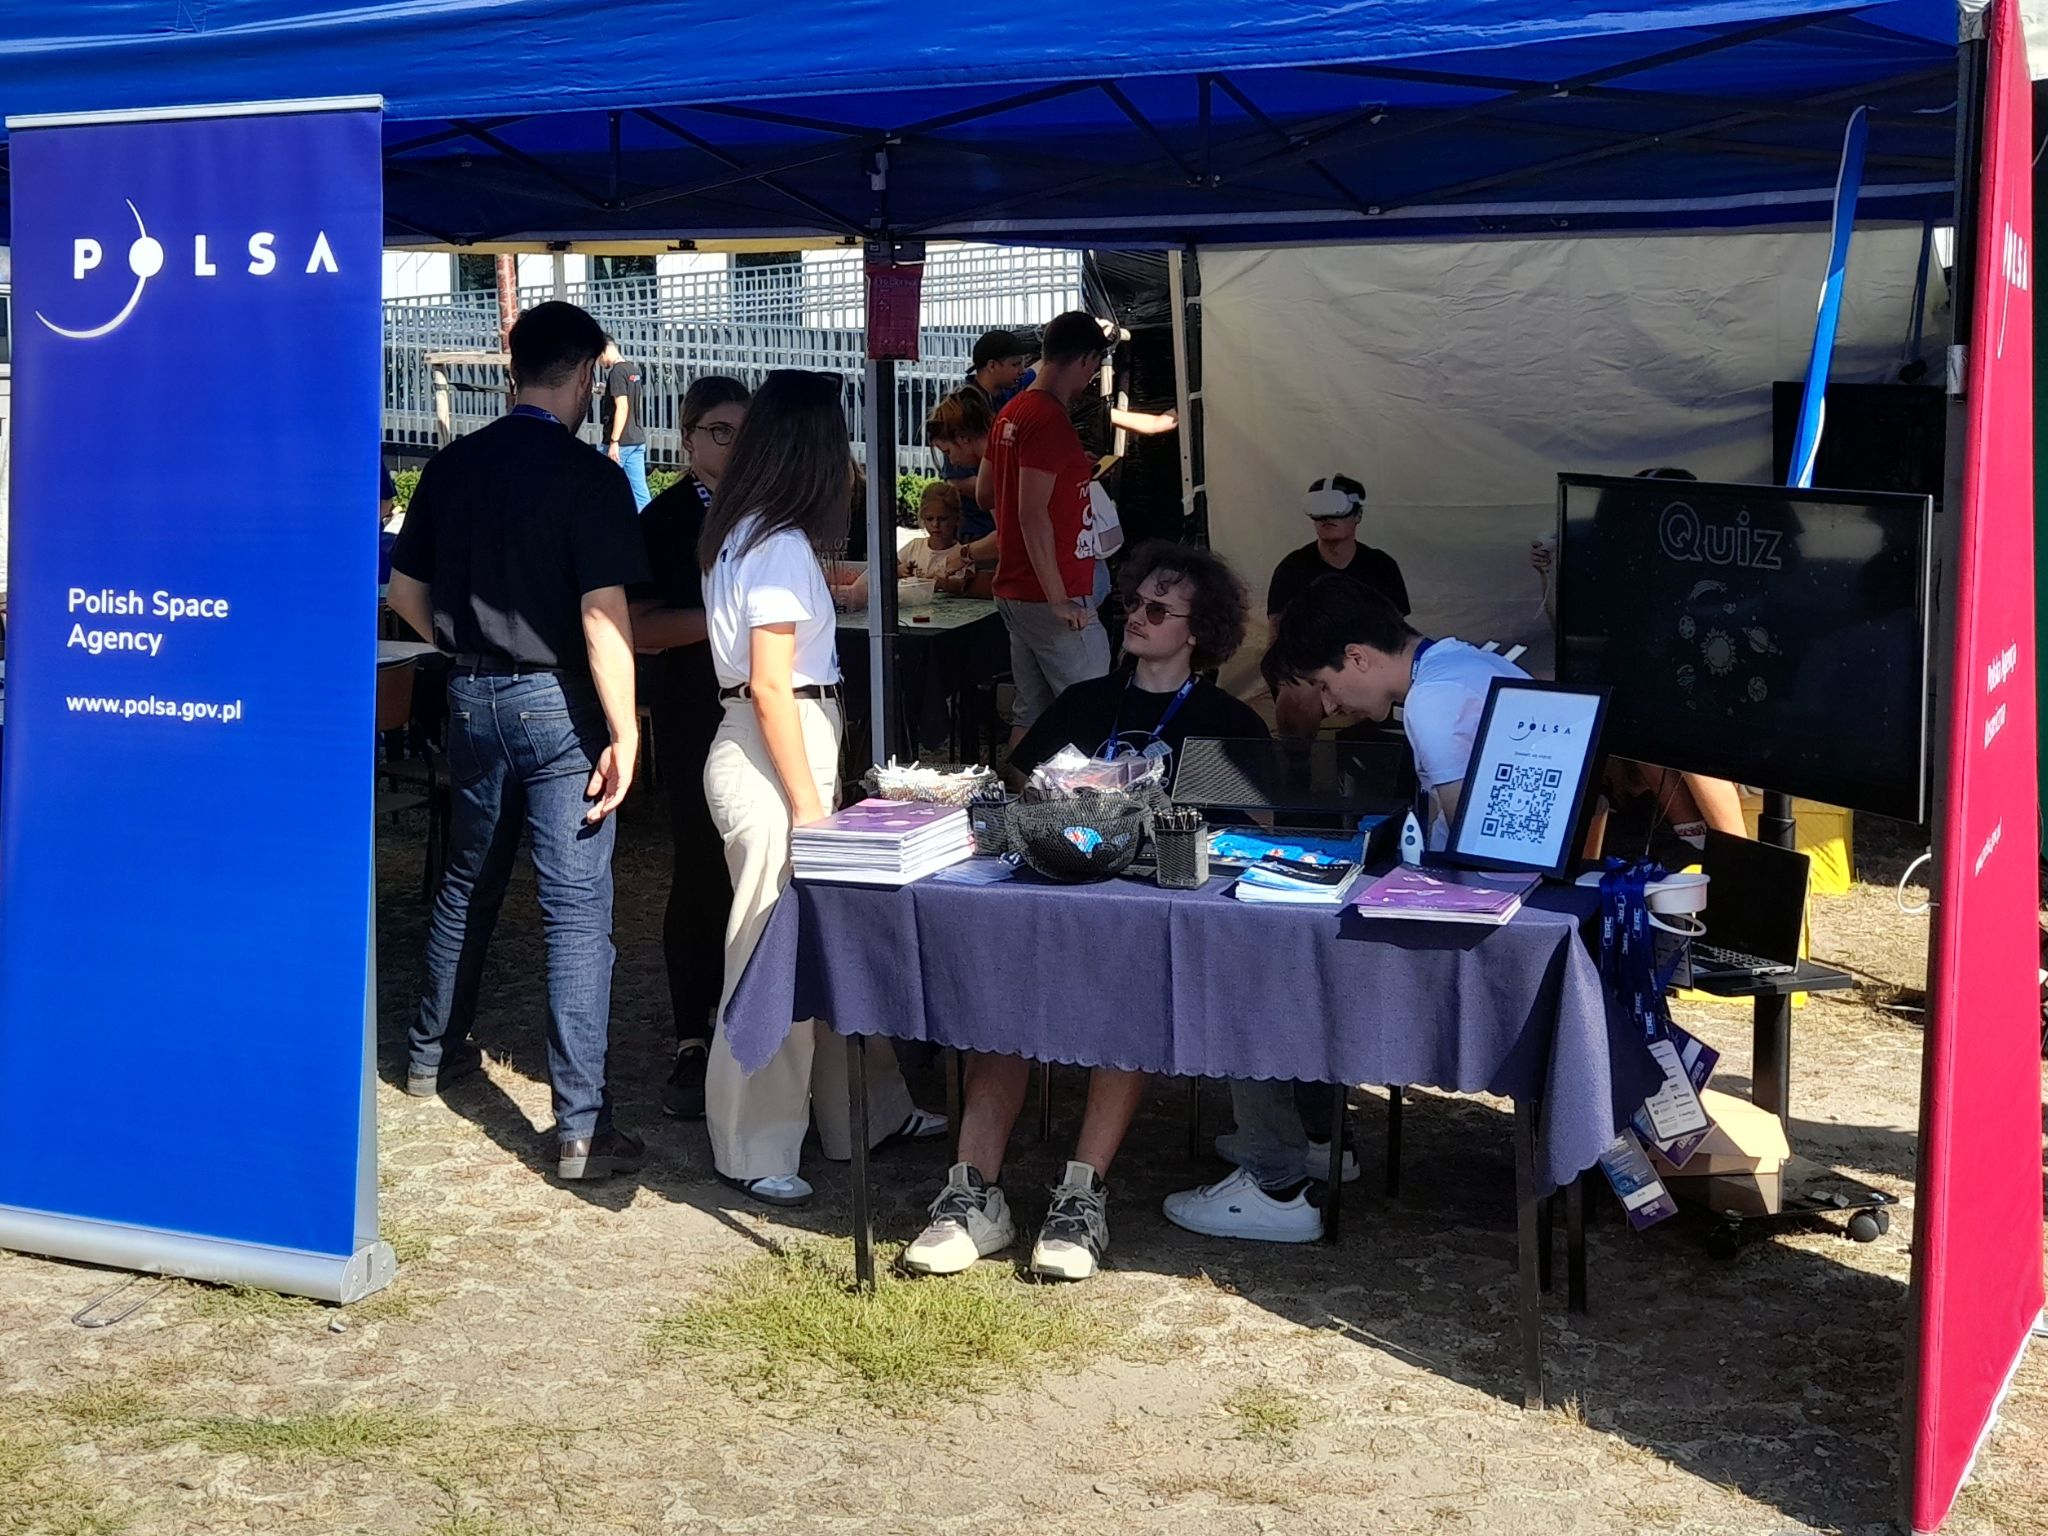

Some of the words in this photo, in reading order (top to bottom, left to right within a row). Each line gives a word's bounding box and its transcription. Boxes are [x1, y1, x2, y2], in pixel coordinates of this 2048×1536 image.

[73, 230, 340, 280] POLSA
[1659, 501, 1783, 570] Quiz
[67, 587, 144, 616] Polish
[152, 590, 229, 622] Space
[67, 623, 163, 657] Agency
[65, 694, 241, 724] www.polsa.gov.pl
[1517, 721, 1571, 735] POLSA
